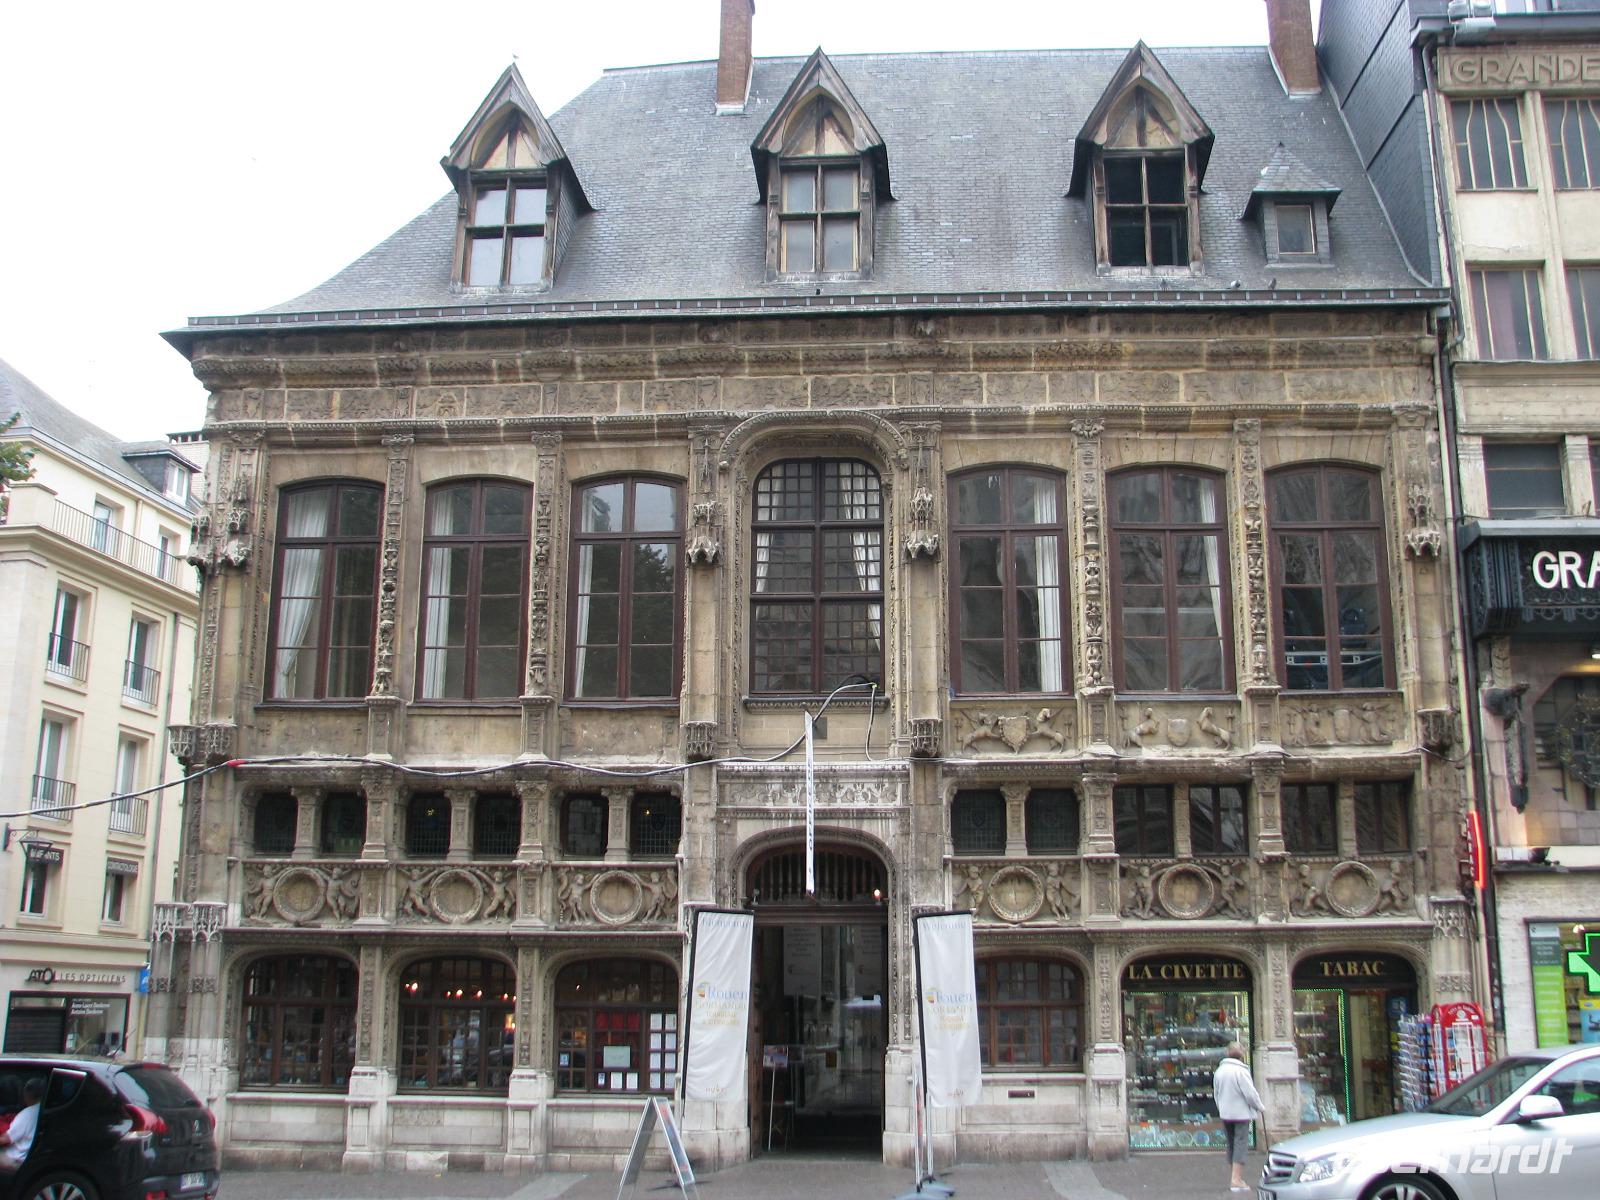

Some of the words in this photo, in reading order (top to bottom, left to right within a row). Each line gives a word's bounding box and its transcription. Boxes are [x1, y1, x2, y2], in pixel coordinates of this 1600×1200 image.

[1128, 964, 1153, 979] LA
[1160, 963, 1244, 979] CIVETTE
[1320, 960, 1385, 977] TABAC
[79, 973, 126, 983] OPTICIENS
